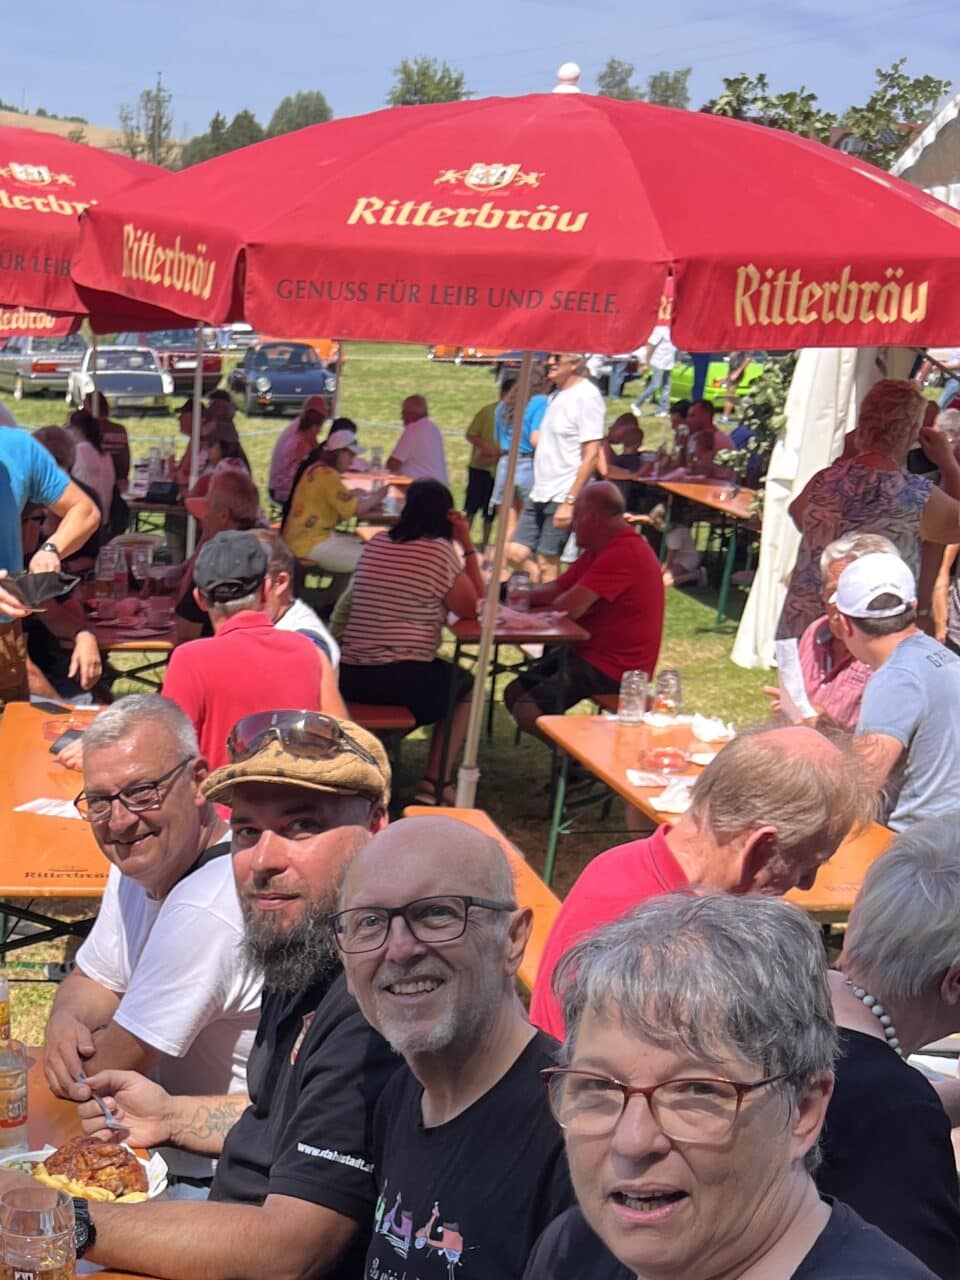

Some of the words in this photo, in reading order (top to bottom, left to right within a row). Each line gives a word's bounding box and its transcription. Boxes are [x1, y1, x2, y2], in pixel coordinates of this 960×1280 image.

[348, 196, 589, 232] Ritterbräu
[123, 224, 215, 300] Ritterbräu
[275, 279, 369, 302] GENUSS
[376, 280, 421, 304] FÜR
[430, 285, 477, 307] LEIB
[490, 287, 544, 310] UND
[550, 290, 621, 315] SEELE.
[737, 264, 929, 326] Ritterbräu
